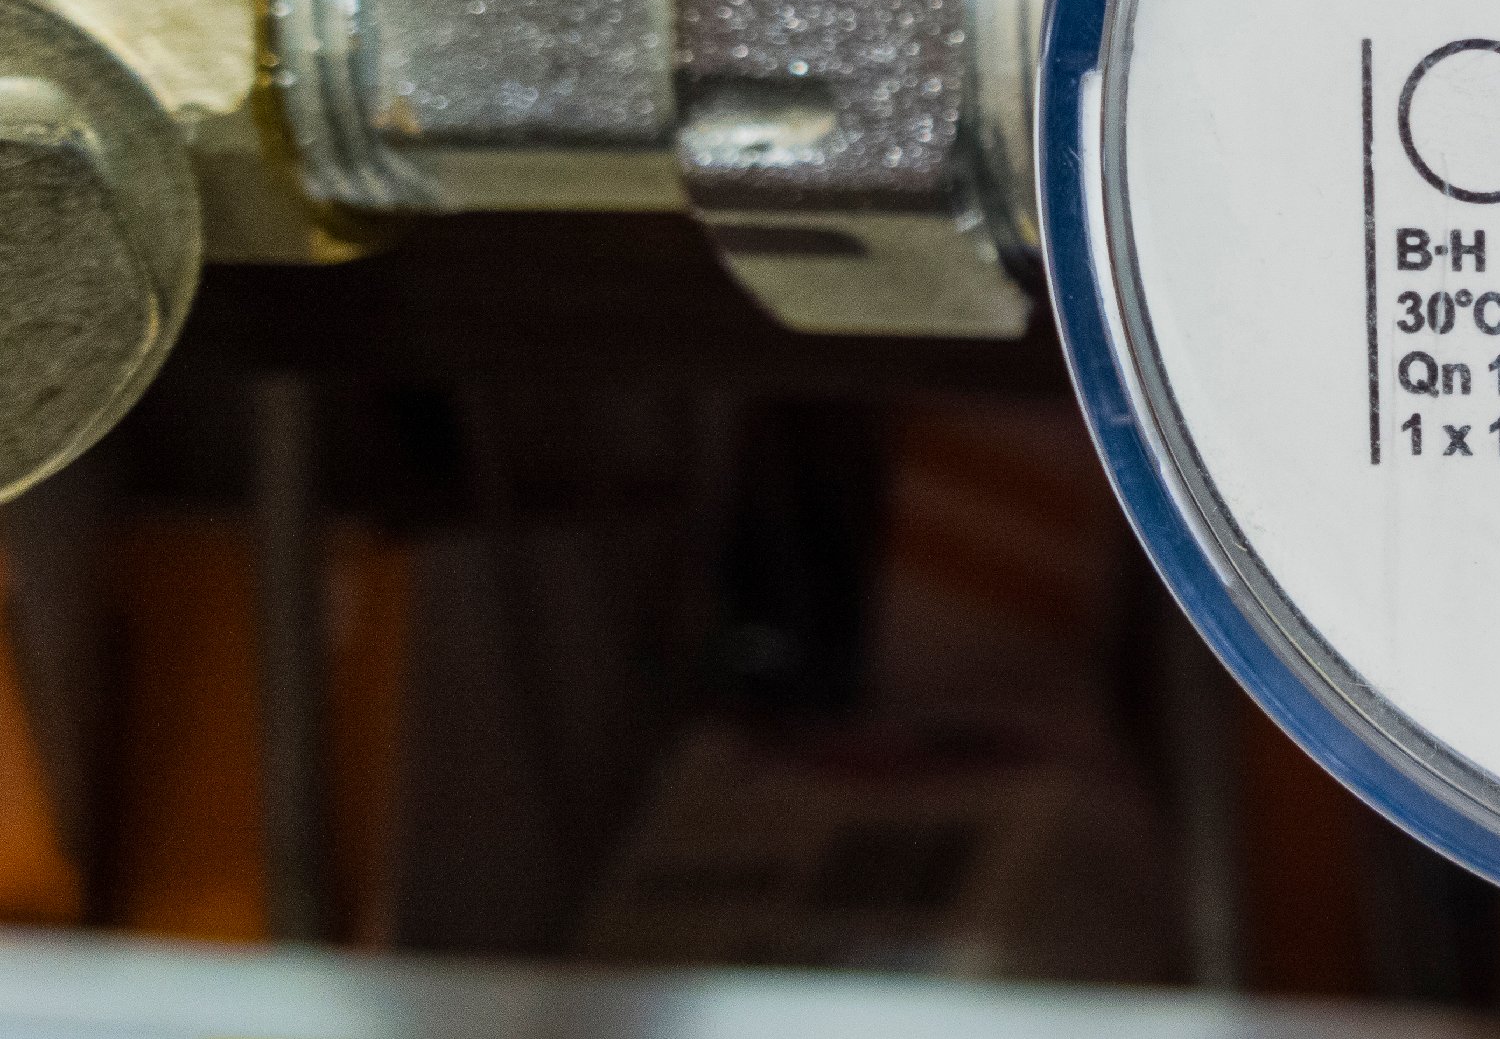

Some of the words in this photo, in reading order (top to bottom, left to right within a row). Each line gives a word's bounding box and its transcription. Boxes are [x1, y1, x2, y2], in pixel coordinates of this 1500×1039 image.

[1396, 227, 1486, 273] B-H
[1398, 351, 1472, 398] Qn
[1401, 412, 1422, 456] 1
[1442, 424, 1473, 457] x
